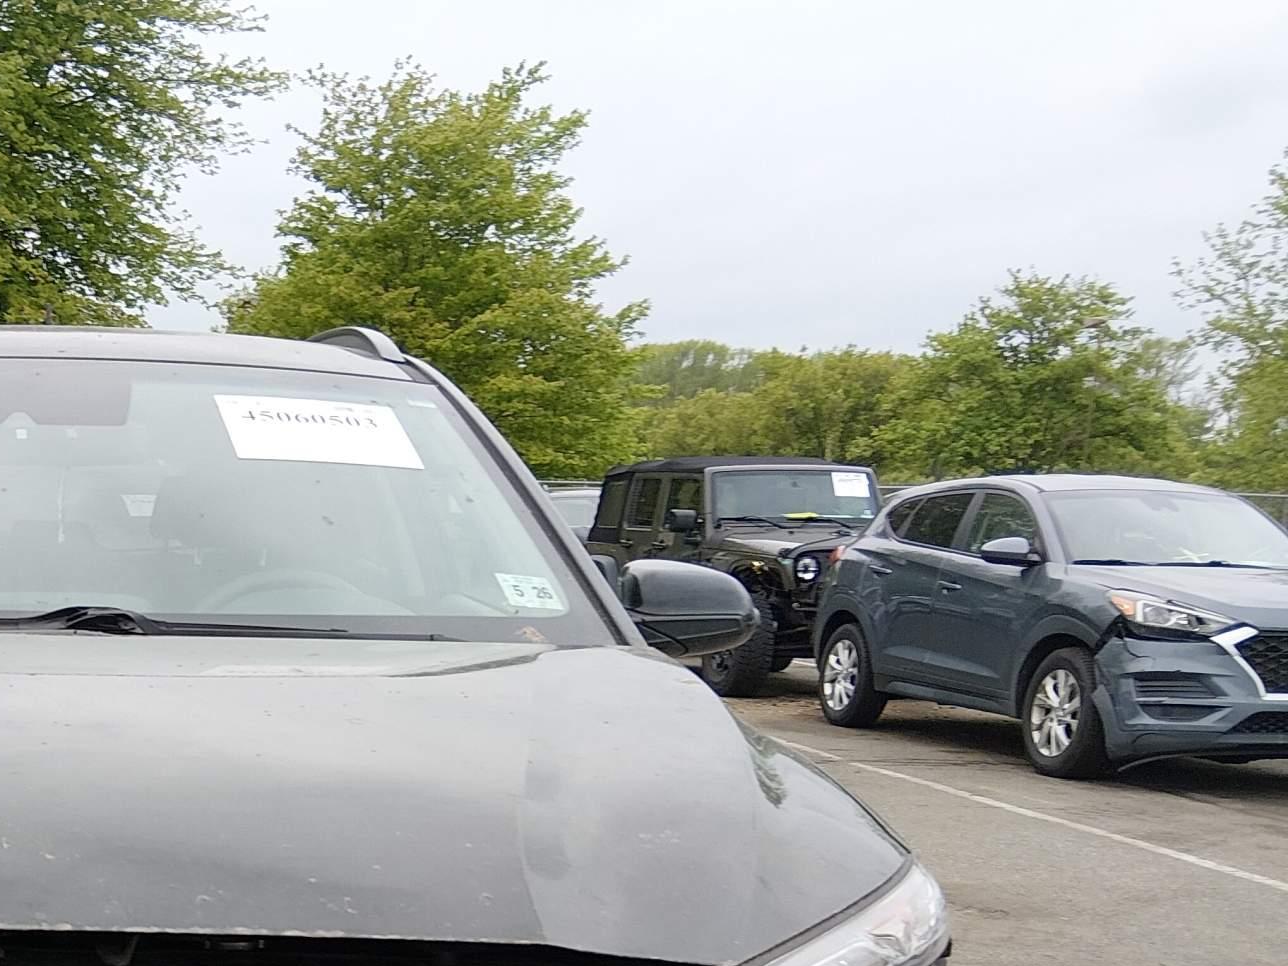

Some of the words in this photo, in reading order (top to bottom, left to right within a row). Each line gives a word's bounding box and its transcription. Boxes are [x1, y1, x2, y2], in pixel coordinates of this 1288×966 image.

[241, 409, 379, 429] 45060503
[511, 584, 524, 598] 5
[531, 586, 554, 600] 26
